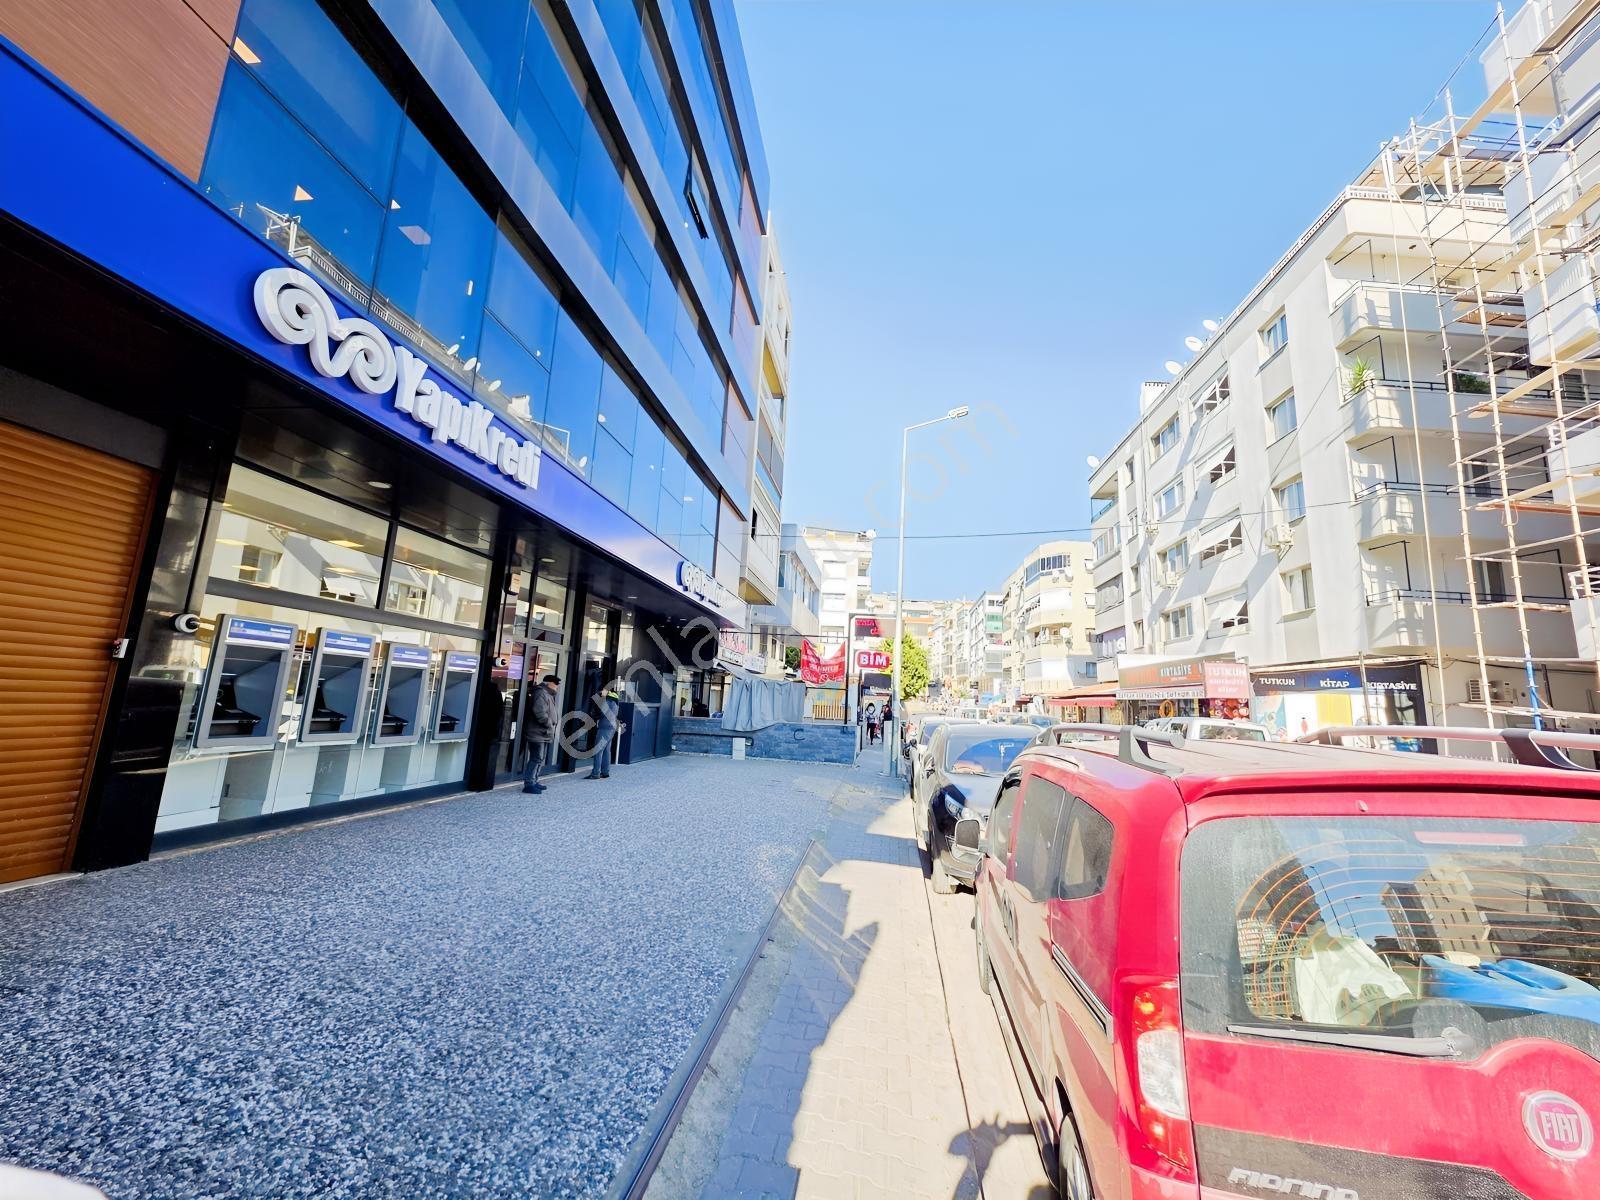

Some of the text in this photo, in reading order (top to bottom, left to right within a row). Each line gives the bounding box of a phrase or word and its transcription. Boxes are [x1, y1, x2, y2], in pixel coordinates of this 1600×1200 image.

[1259, 677, 1296, 686] TUTKUN
[1319, 678, 1350, 688] KİTAP
[1539, 1109, 1579, 1144] FIAT
